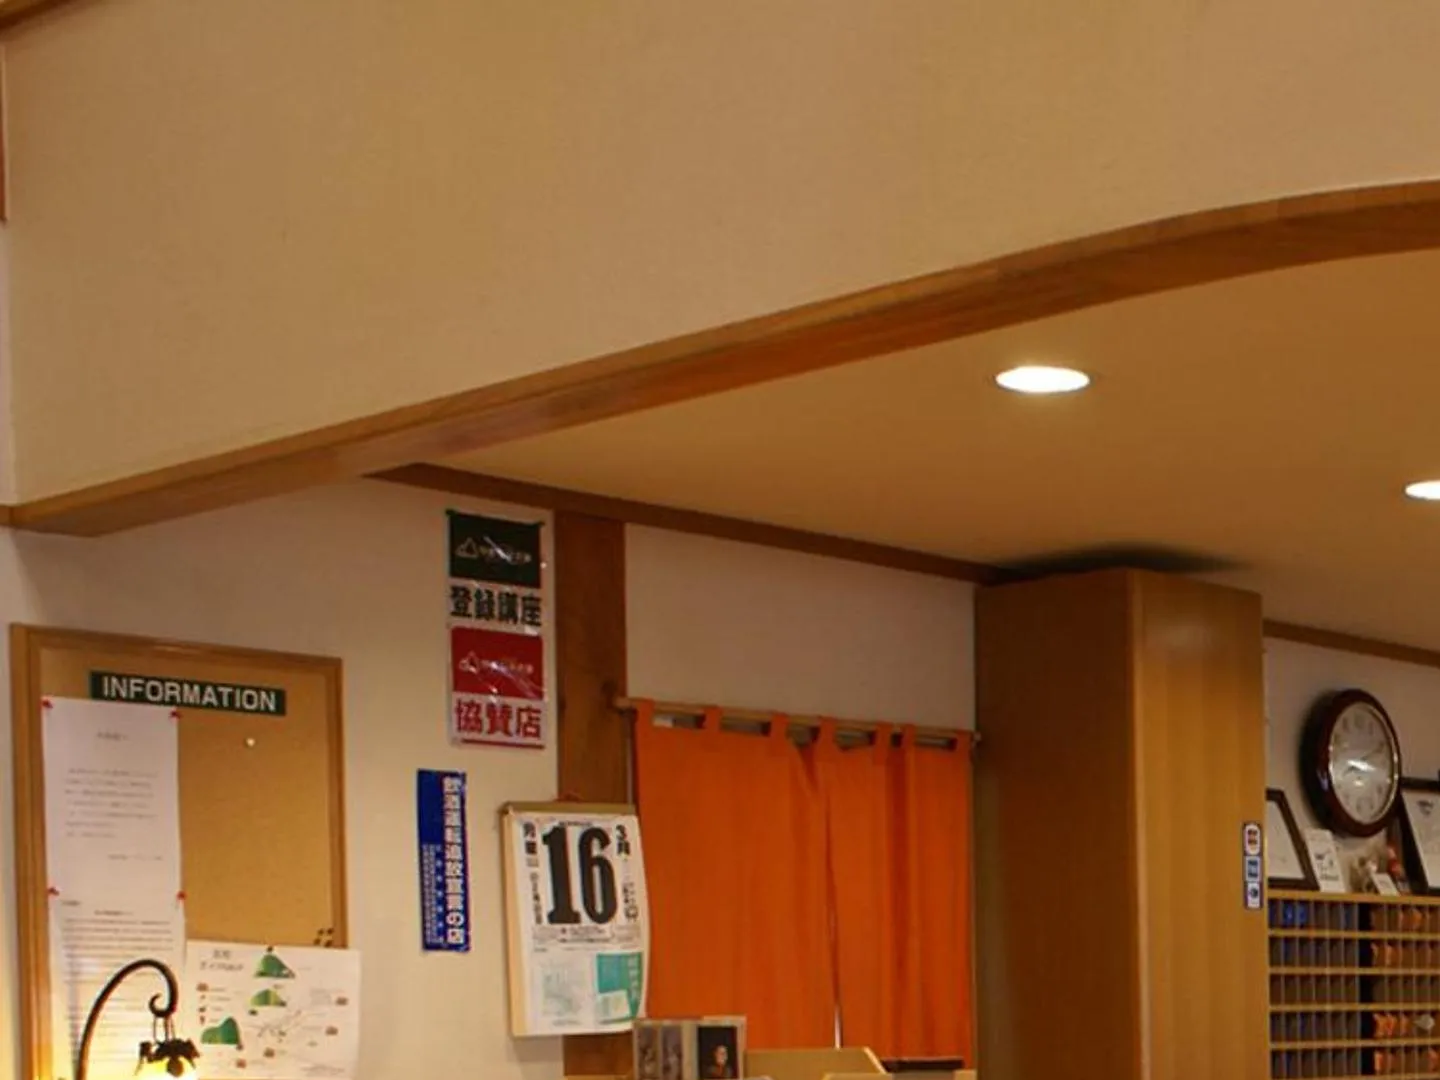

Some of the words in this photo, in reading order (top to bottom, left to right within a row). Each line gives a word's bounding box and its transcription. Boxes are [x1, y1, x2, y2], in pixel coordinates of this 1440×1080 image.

[450, 585, 543, 628] 登録講座
[102, 675, 277, 713] INFORMATION
[455, 698, 542, 738] 協賛店
[542, 825, 618, 925] 16
